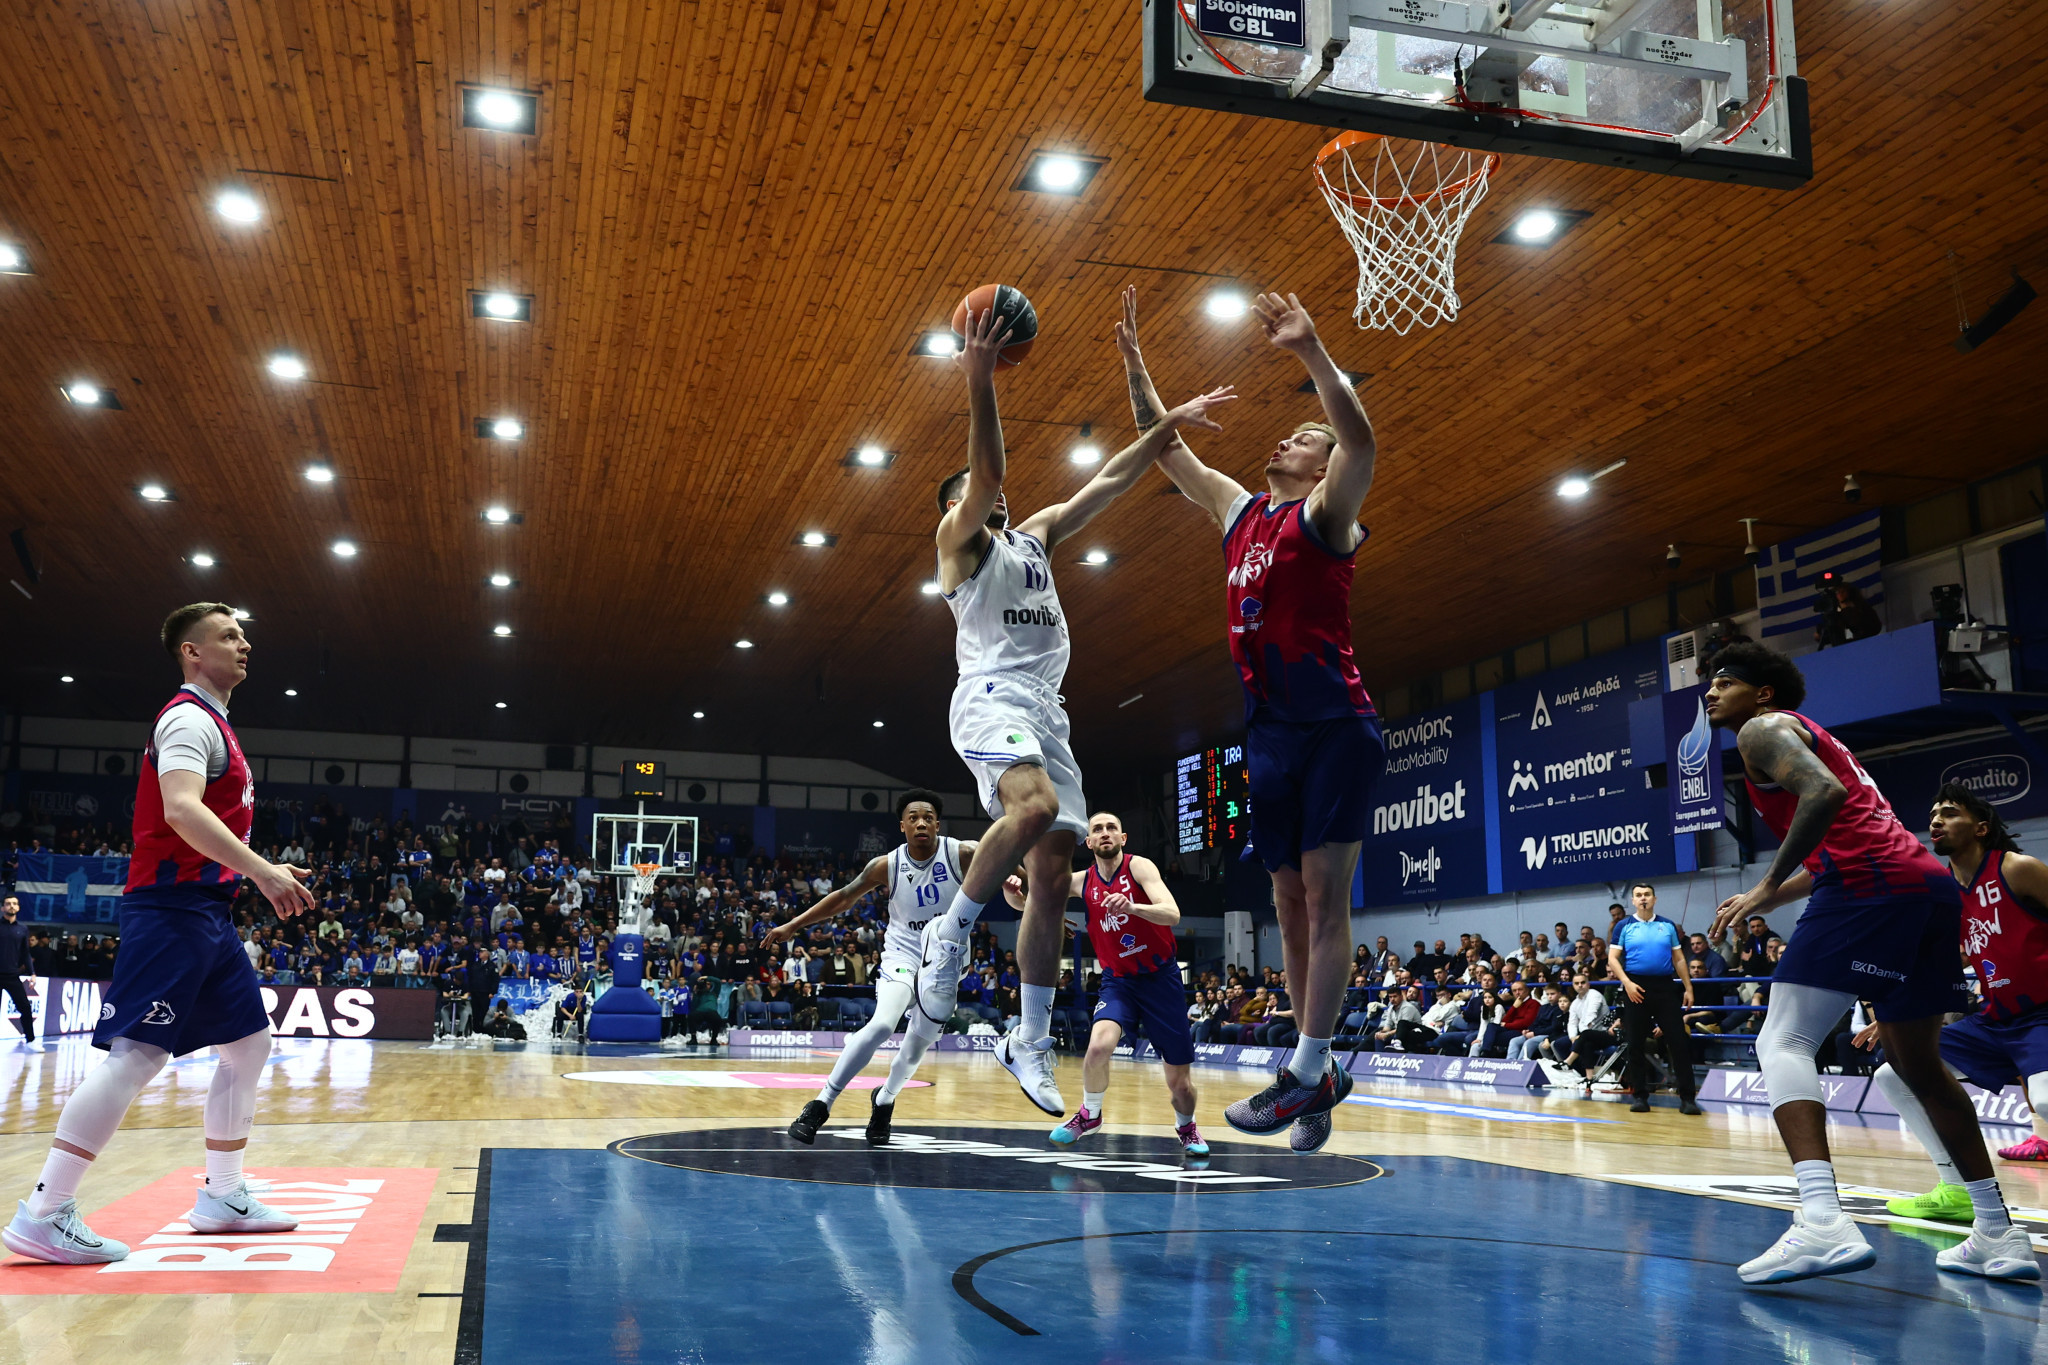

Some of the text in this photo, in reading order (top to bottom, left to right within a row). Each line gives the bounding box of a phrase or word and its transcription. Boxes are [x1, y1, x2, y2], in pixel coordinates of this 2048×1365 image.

[1206, 0, 1296, 22] Stoiximan
[1389, 6, 1413, 16] nuova
[1229, 16, 1274, 37] GBL
[1646, 47, 1670, 55] nuova
[1023, 561, 1047, 591] 10
[1003, 605, 1064, 631] novibe
[1555, 687, 1580, 706] Αυγά
[1583, 675, 1620, 698] Λαβιδά
[1580, 704, 1594, 713] 1958
[1382, 715, 1452, 750] Γιαννίρης
[1224, 745, 1242, 766] IRA
[1385, 746, 1449, 775] AutoMobility
[1544, 751, 1614, 784] mentor
[1682, 776, 1707, 800] ENBL
[1373, 779, 1466, 835] novibet
[1676, 806, 1717, 820] European North
[1229, 824, 1235, 839] 5
[1551, 822, 1649, 853] TRUEWORK
[1674, 821, 1721, 834] Basketball League
[1553, 846, 1651, 865] FACILITY SOLUTIONS
[1119, 874, 1130, 893] 5
[1976, 880, 2002, 908] 16
[916, 884, 939, 907] 19
[750, 1031, 813, 1045] novibet
[1369, 1054, 1424, 1072] Γιαννίρης
[1971, 1088, 2032, 1124] dito
